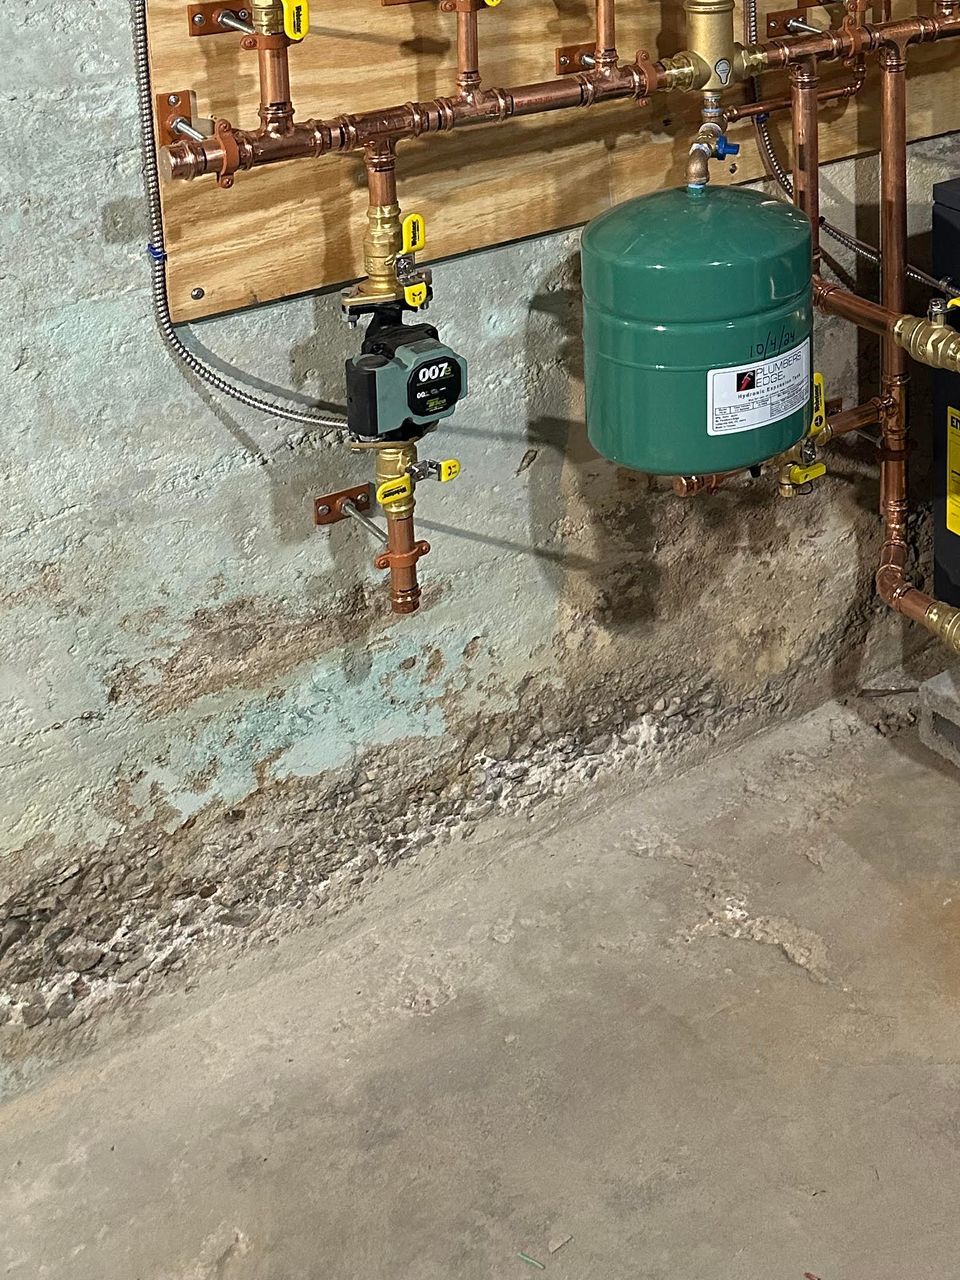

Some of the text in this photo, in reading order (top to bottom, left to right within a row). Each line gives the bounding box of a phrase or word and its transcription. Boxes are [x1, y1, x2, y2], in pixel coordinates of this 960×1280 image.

[750, 326, 796, 359] 10/4/24
[756, 351, 801, 376] PLUMBERS
[738, 389, 765, 399] Hydronic
